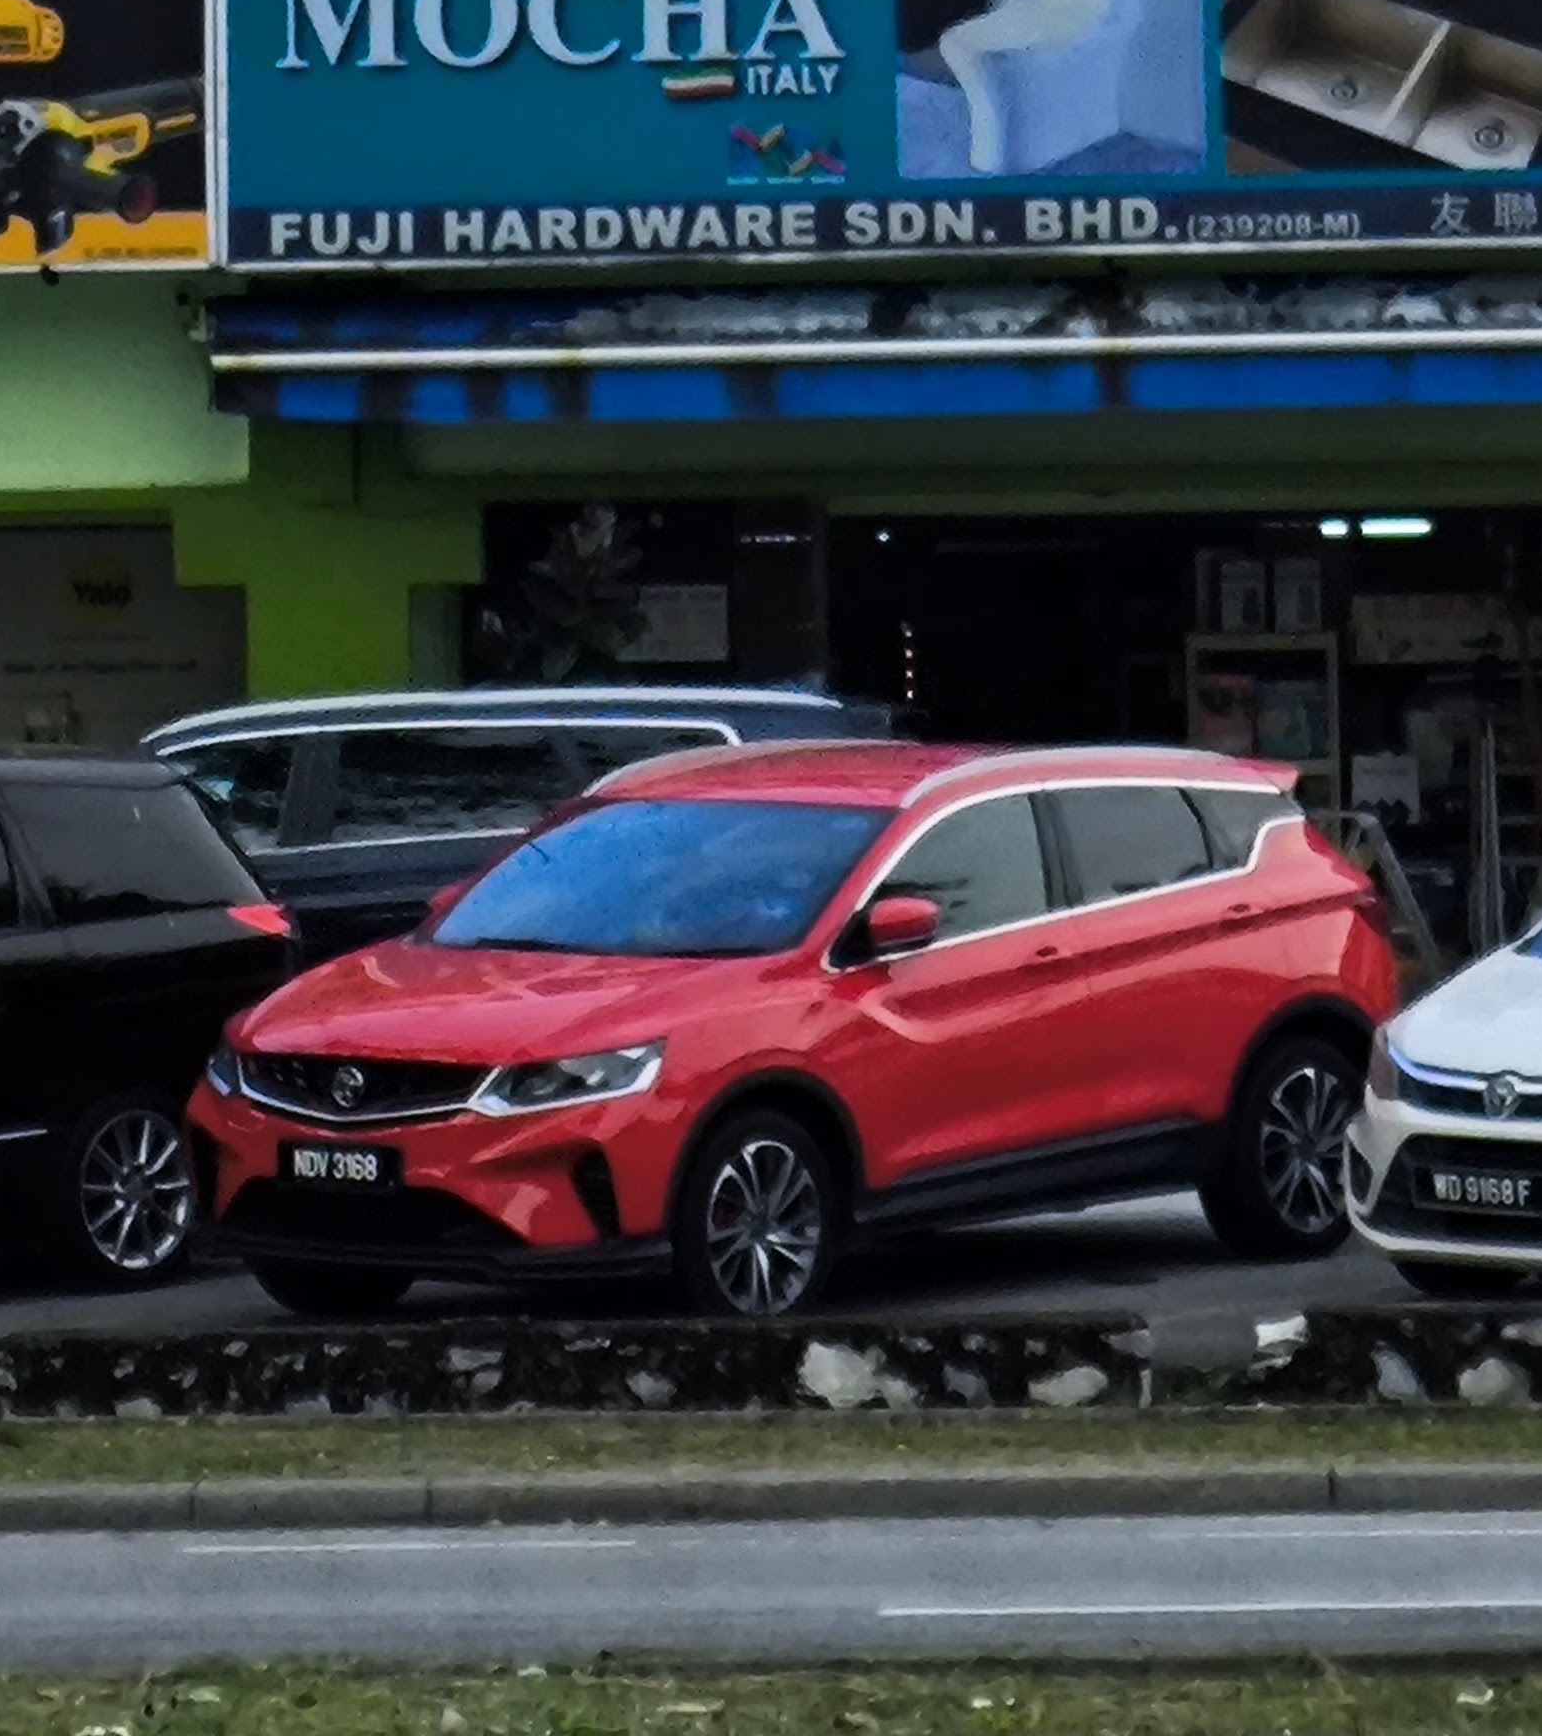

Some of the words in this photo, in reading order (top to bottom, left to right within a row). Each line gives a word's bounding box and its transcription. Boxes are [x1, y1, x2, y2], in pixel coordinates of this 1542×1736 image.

[745, 63, 839, 97] ITALY
[270, 211, 415, 257] FUJI
[443, 204, 817, 254] HARDWARE
[843, 200, 997, 248] SDN.
[1025, 196, 1179, 244] BHD.
